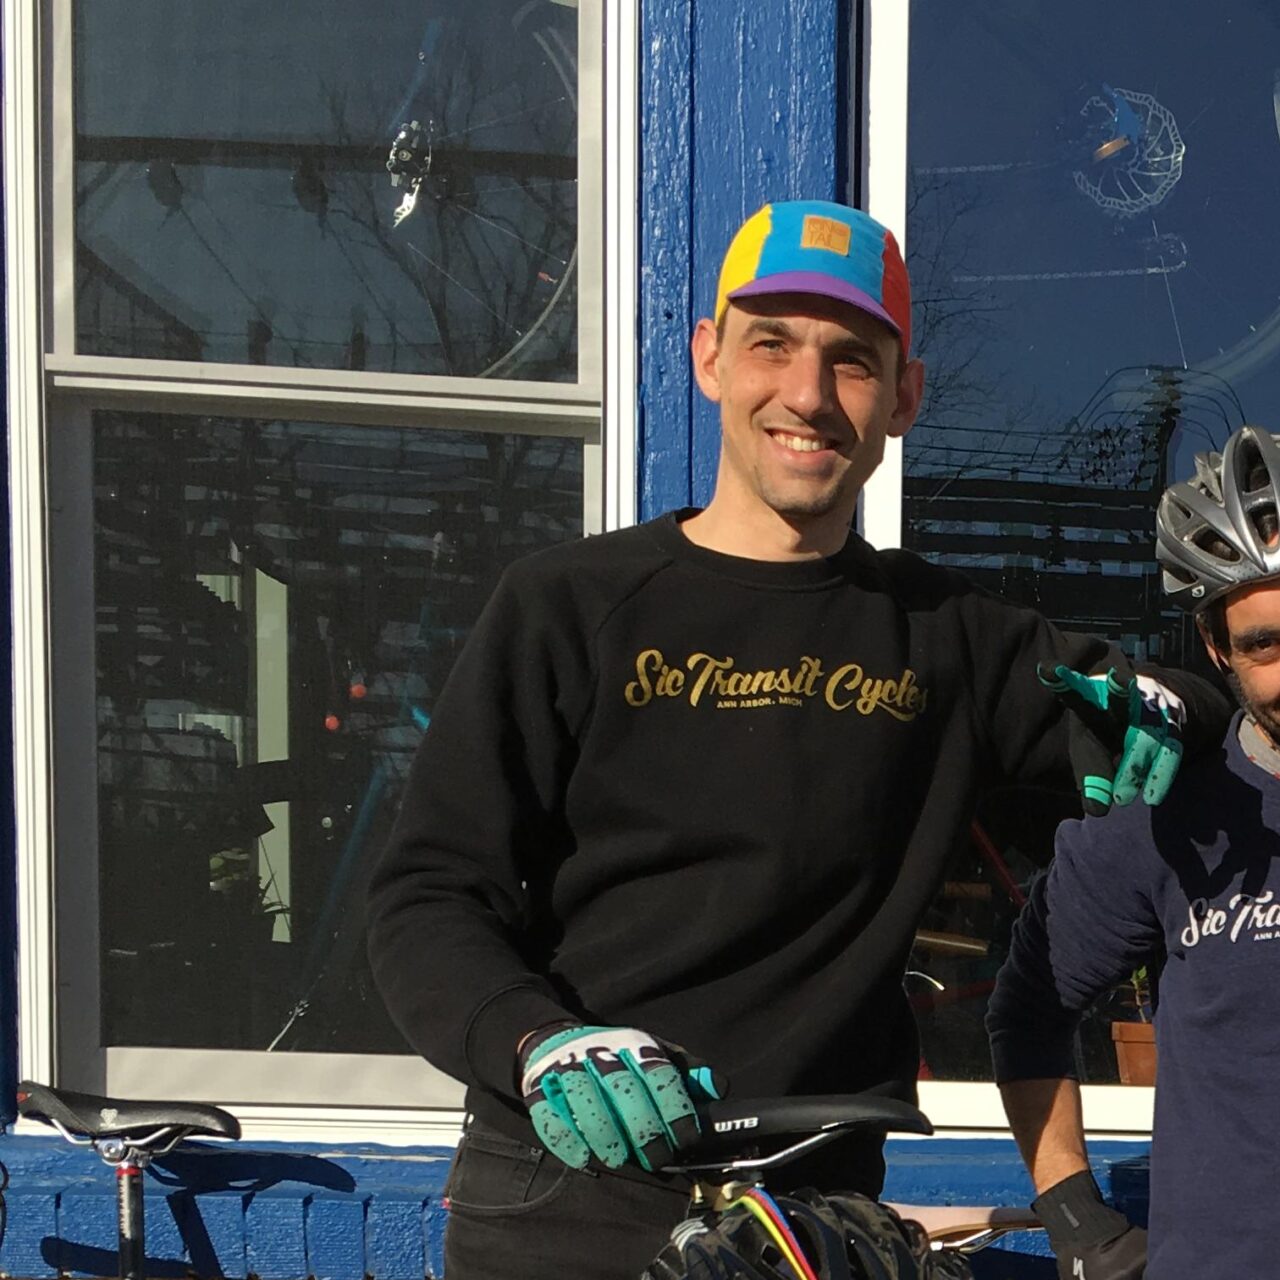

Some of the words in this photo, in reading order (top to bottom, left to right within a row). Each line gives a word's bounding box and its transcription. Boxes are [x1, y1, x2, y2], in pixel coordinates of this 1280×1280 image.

[624, 649, 685, 707] Sic
[687, 653, 825, 707] Transit
[825, 664, 928, 721] Cycles
[716, 700, 737, 709] ANN
[779, 696, 802, 706] MICH
[1181, 897, 1226, 948] Sic
[1254, 932, 1273, 942] ANN
[714, 1117, 759, 1133] WTB
